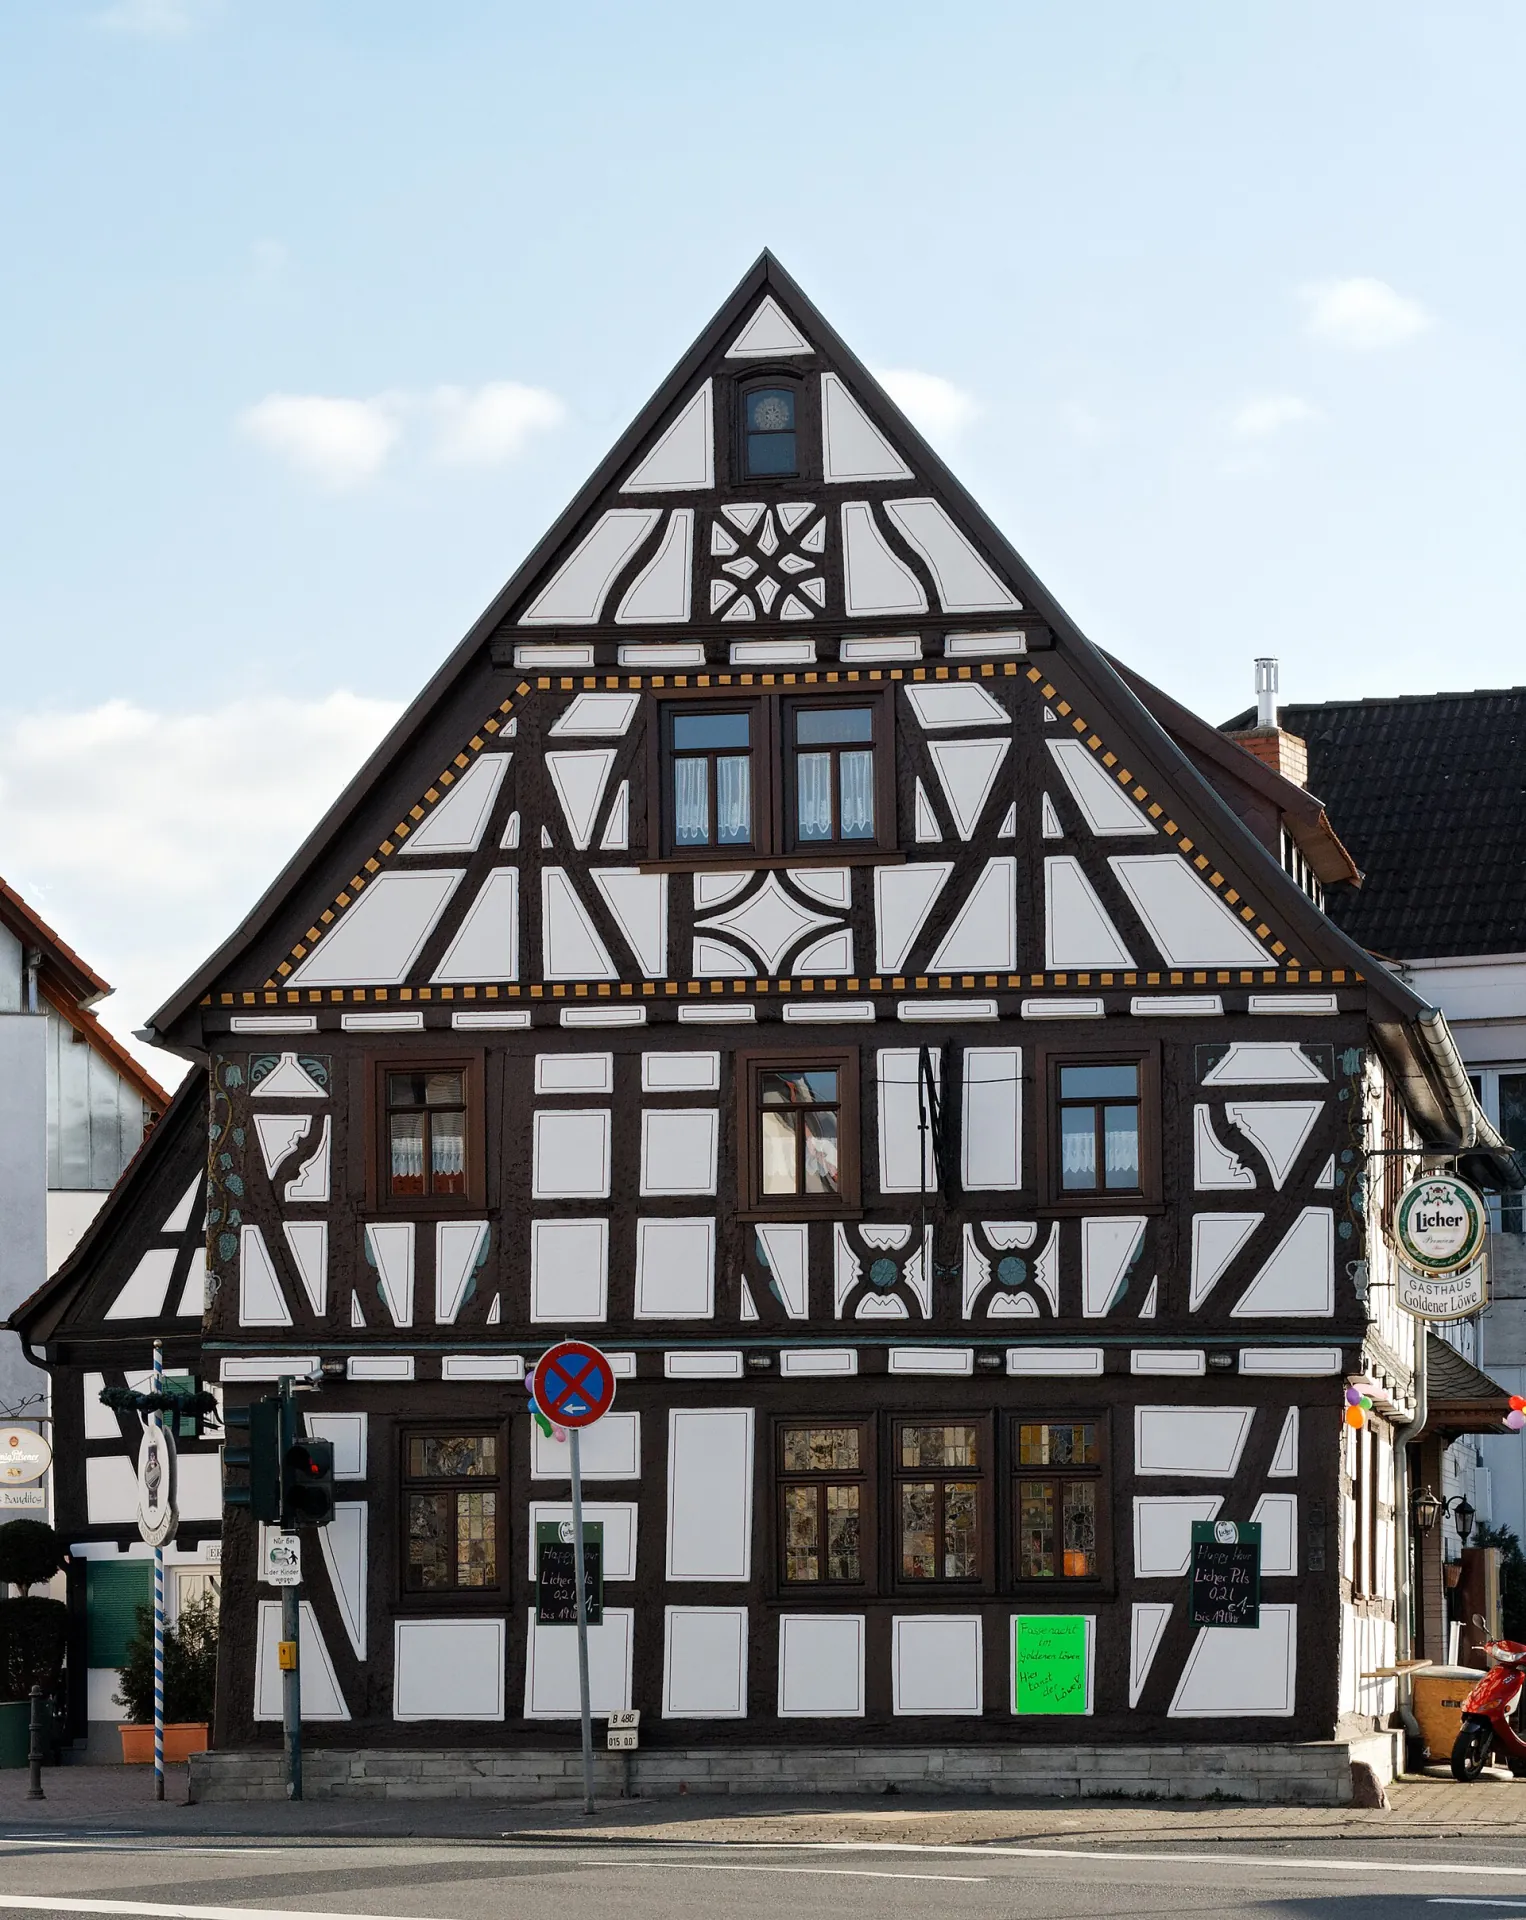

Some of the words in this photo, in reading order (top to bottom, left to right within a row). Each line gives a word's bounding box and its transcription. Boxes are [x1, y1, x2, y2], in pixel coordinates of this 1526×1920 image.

[1416, 1211, 1463, 1232] Licher
[1423, 1235, 1455, 1244] Premium
[1409, 1278, 1471, 1295] GASTHAUS
[1404, 1290, 1447, 1313] Goldener
[1451, 1291, 1477, 1311] Löwe
[4, 1492, 42, 1504] Banditos
[1198, 1544, 1229, 1564] Happy
[1232, 1546, 1252, 1560] Hour
[541, 1571, 572, 1587] Licher
[1194, 1567, 1228, 1585] Licher
[1230, 1567, 1250, 1584] Pils
[540, 1608, 555, 1619] bis
[1194, 1610, 1210, 1623] bis
[1020, 1671, 1038, 1683] Hier
[1043, 1683, 1058, 1697] der
[612, 1714, 618, 1724] B
